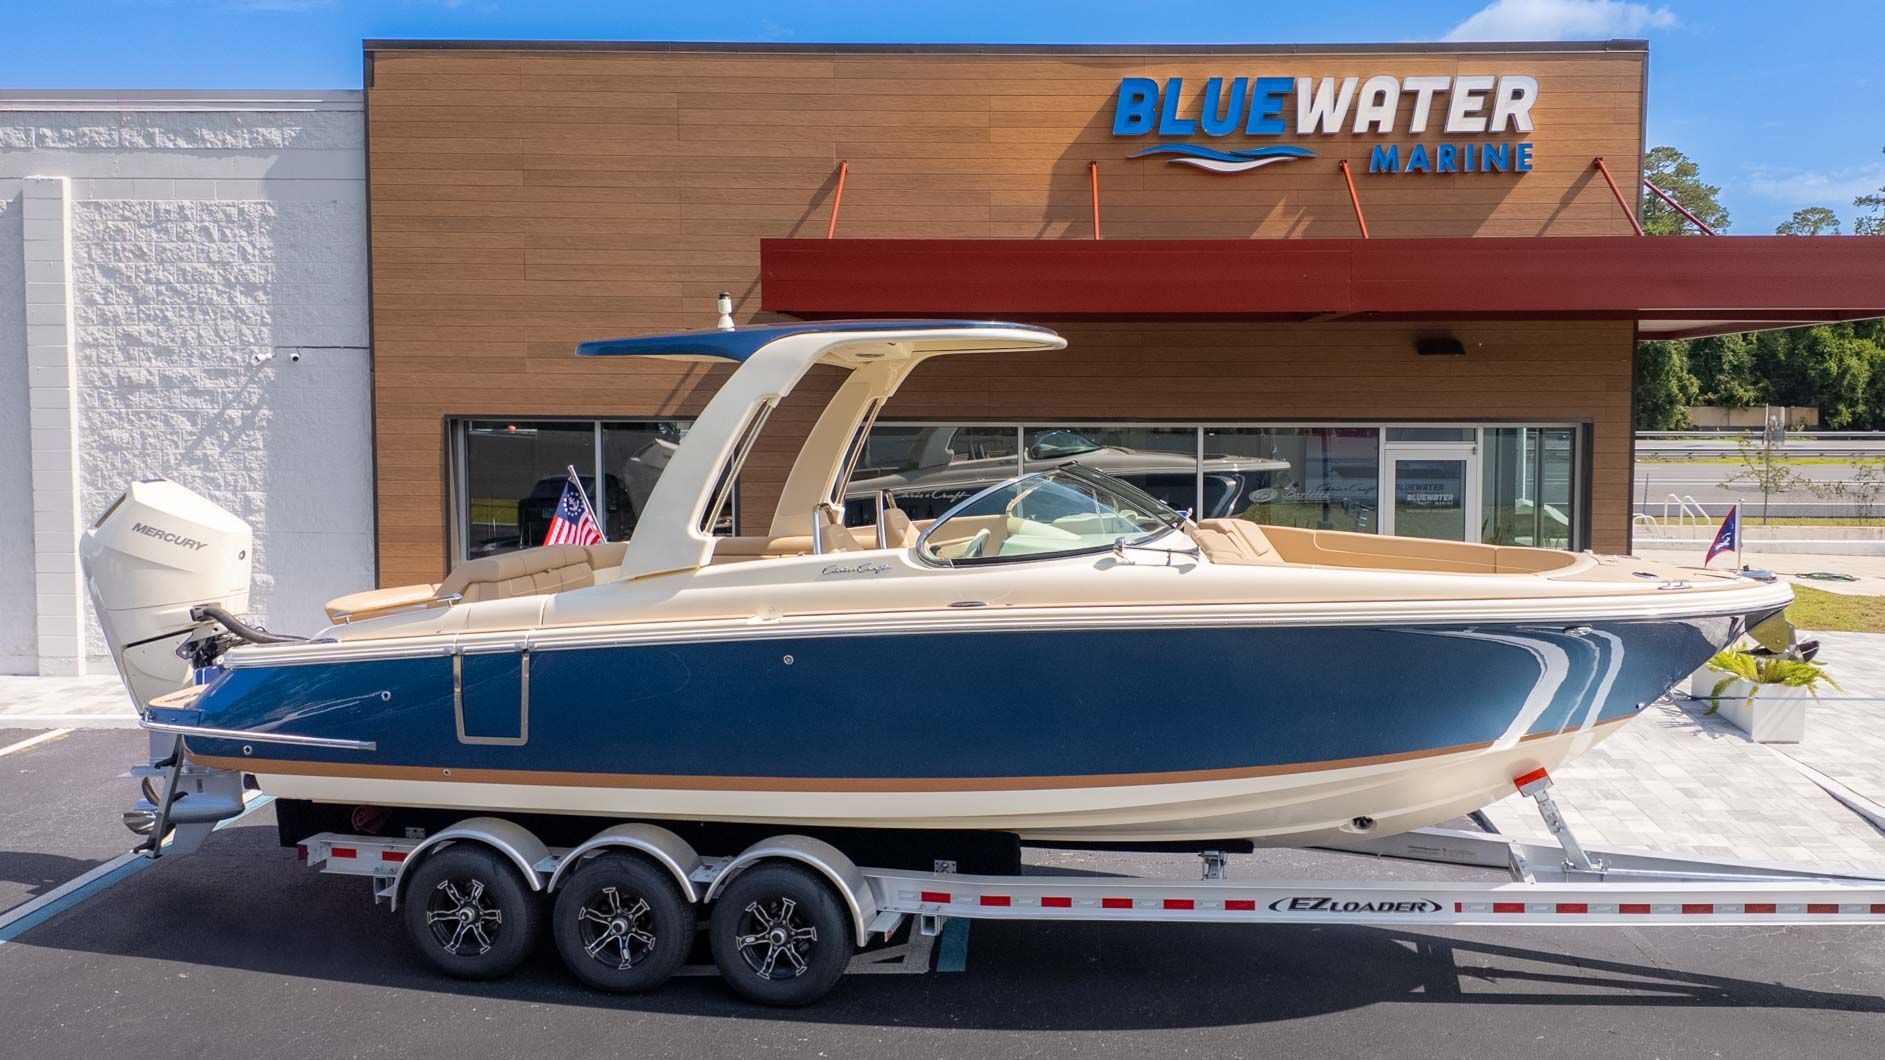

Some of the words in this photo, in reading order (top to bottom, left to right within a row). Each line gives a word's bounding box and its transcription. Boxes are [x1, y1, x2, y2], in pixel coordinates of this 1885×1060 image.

[1113, 76, 1539, 135] BLUEWATER
[1369, 143, 1533, 173] MARINE
[132, 522, 208, 551] MERCURY
